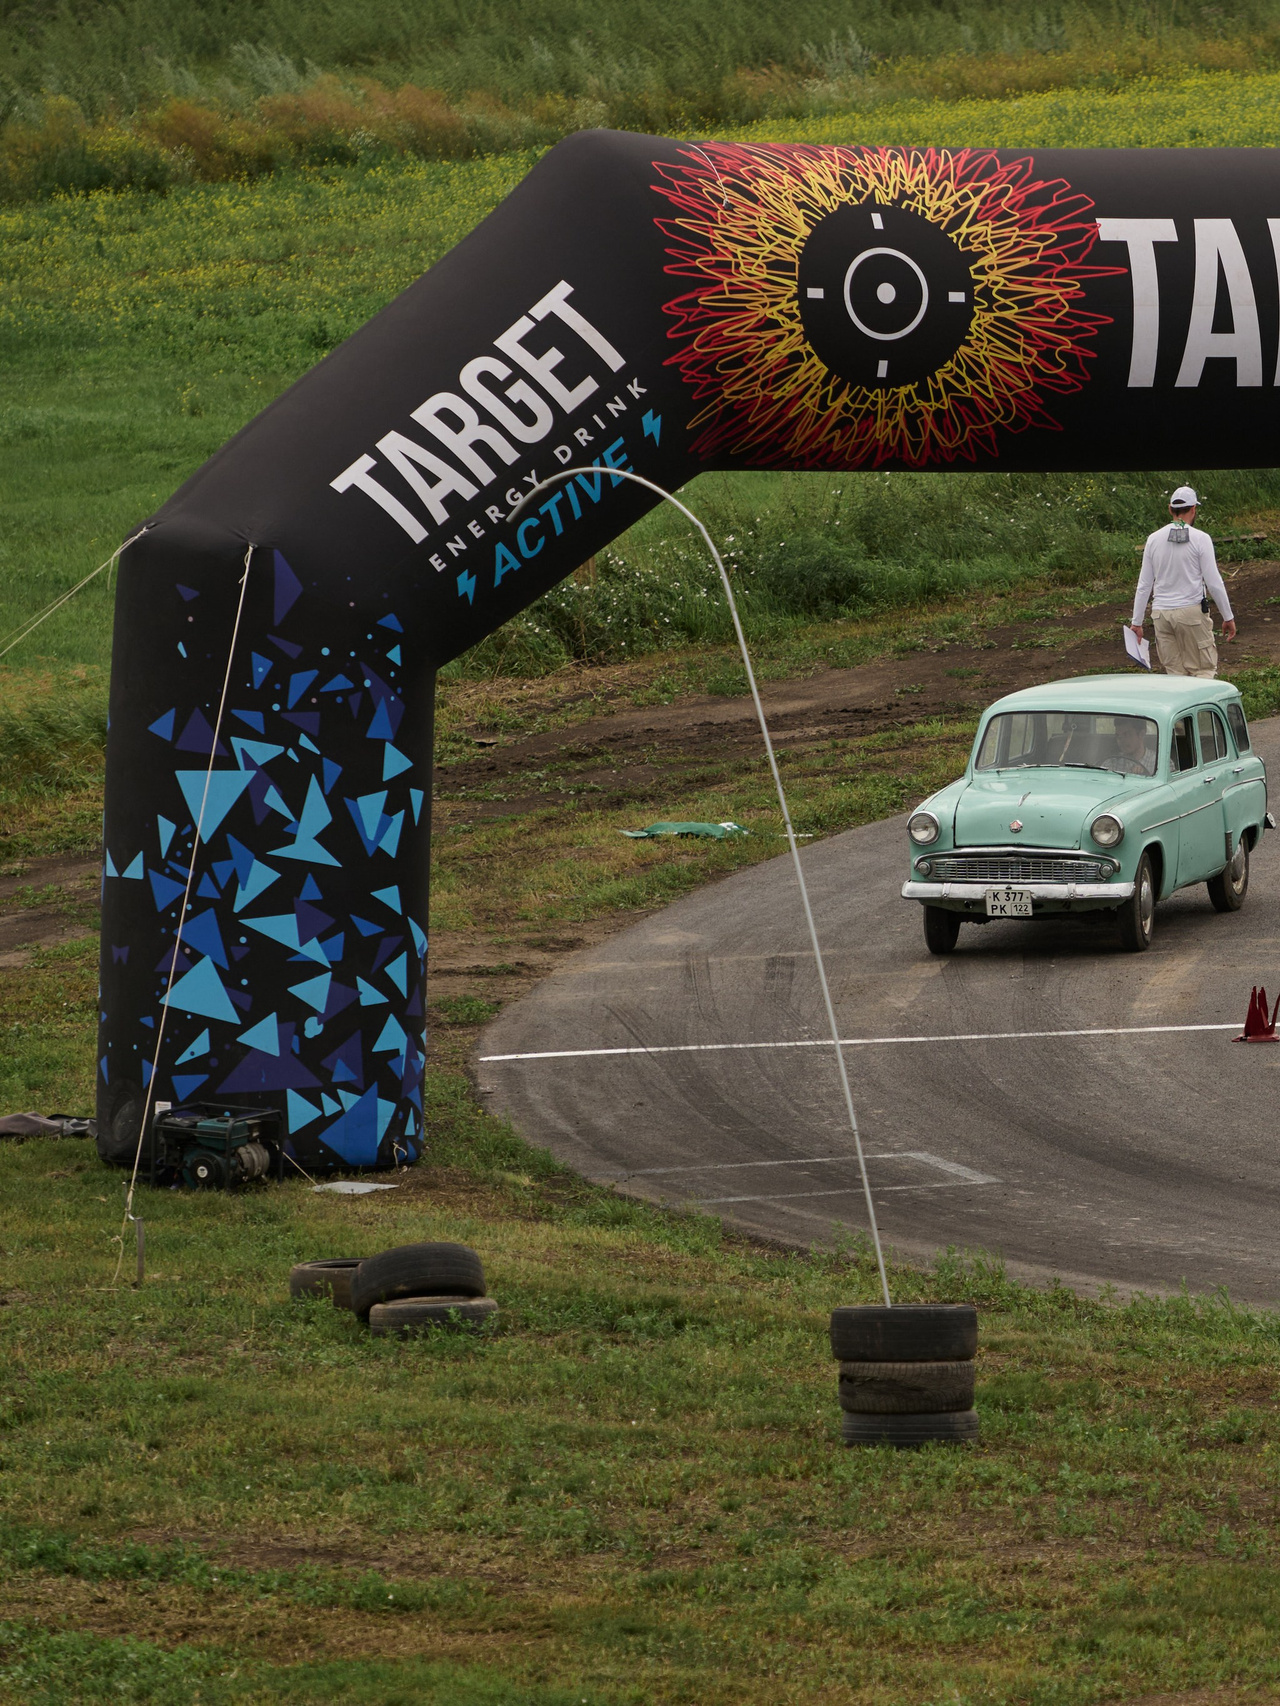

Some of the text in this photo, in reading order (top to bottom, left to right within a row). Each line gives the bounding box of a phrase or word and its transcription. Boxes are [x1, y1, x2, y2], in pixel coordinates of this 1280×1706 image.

[329, 279, 627, 545] TARGET
[428, 377, 648, 573] ENERGY DRINK
[493, 436, 634, 589] ACTIVE
[1004, 892, 1024, 902] 377
[1013, 904, 1029, 912] 122
